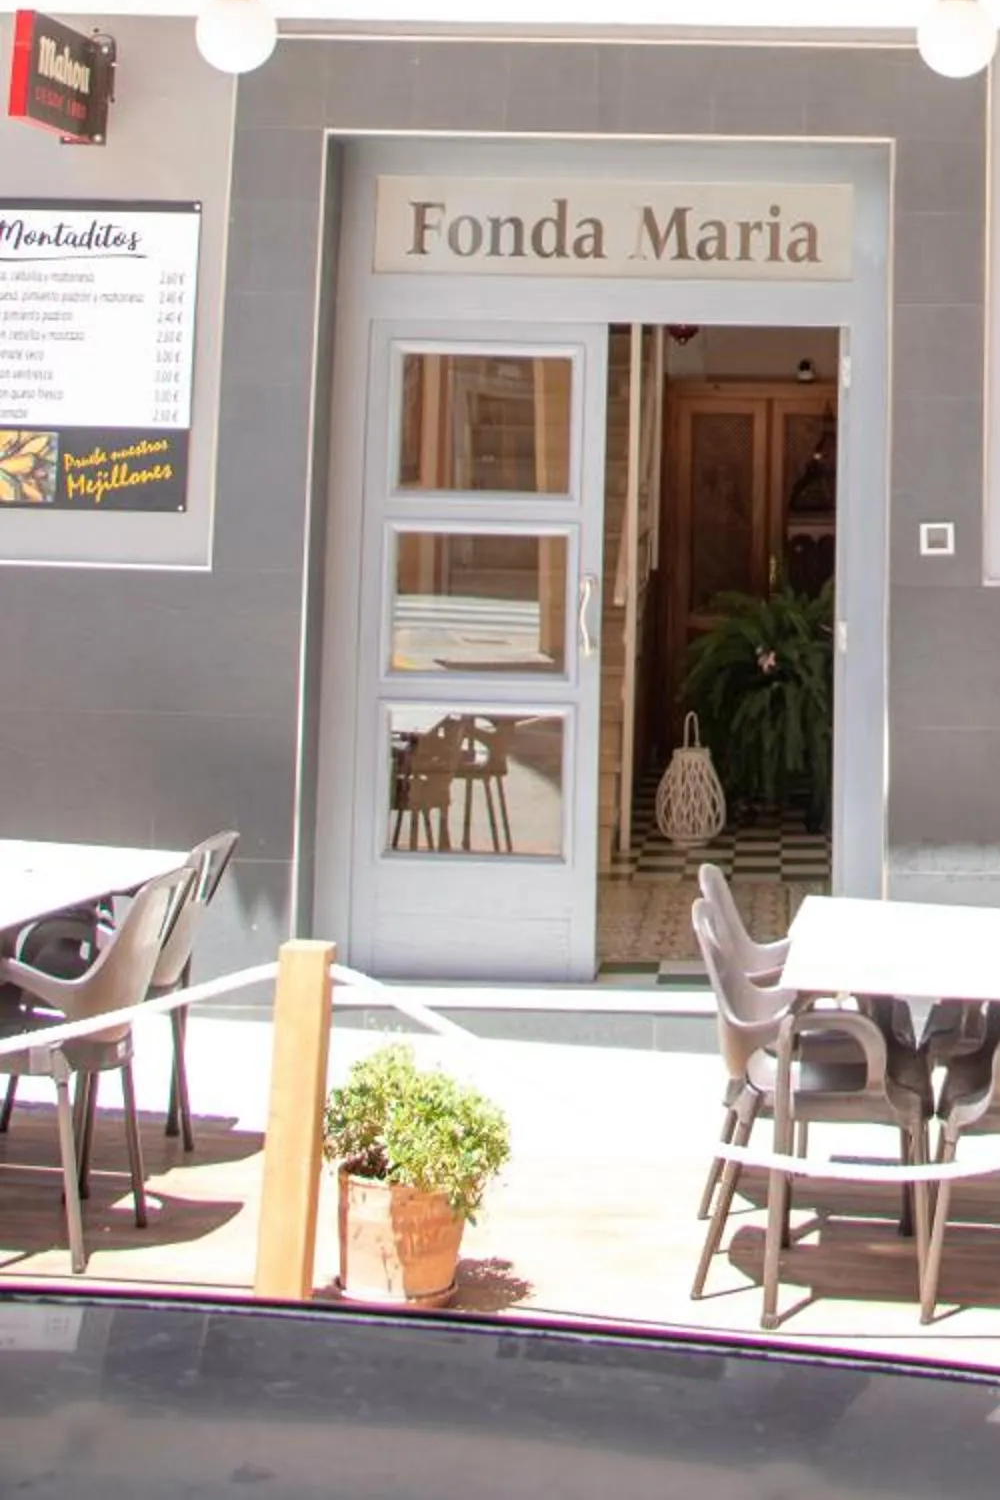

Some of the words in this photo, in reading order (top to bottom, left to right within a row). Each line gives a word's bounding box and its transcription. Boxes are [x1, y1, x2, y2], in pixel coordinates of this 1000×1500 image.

[38, 35, 90, 94] Mahou
[0, 219, 142, 251] Montaditos
[406, 199, 608, 260] Fonda
[628, 204, 823, 264] Maria
[111, 439, 169, 460] nuestros
[67, 463, 173, 503] Mejillones
